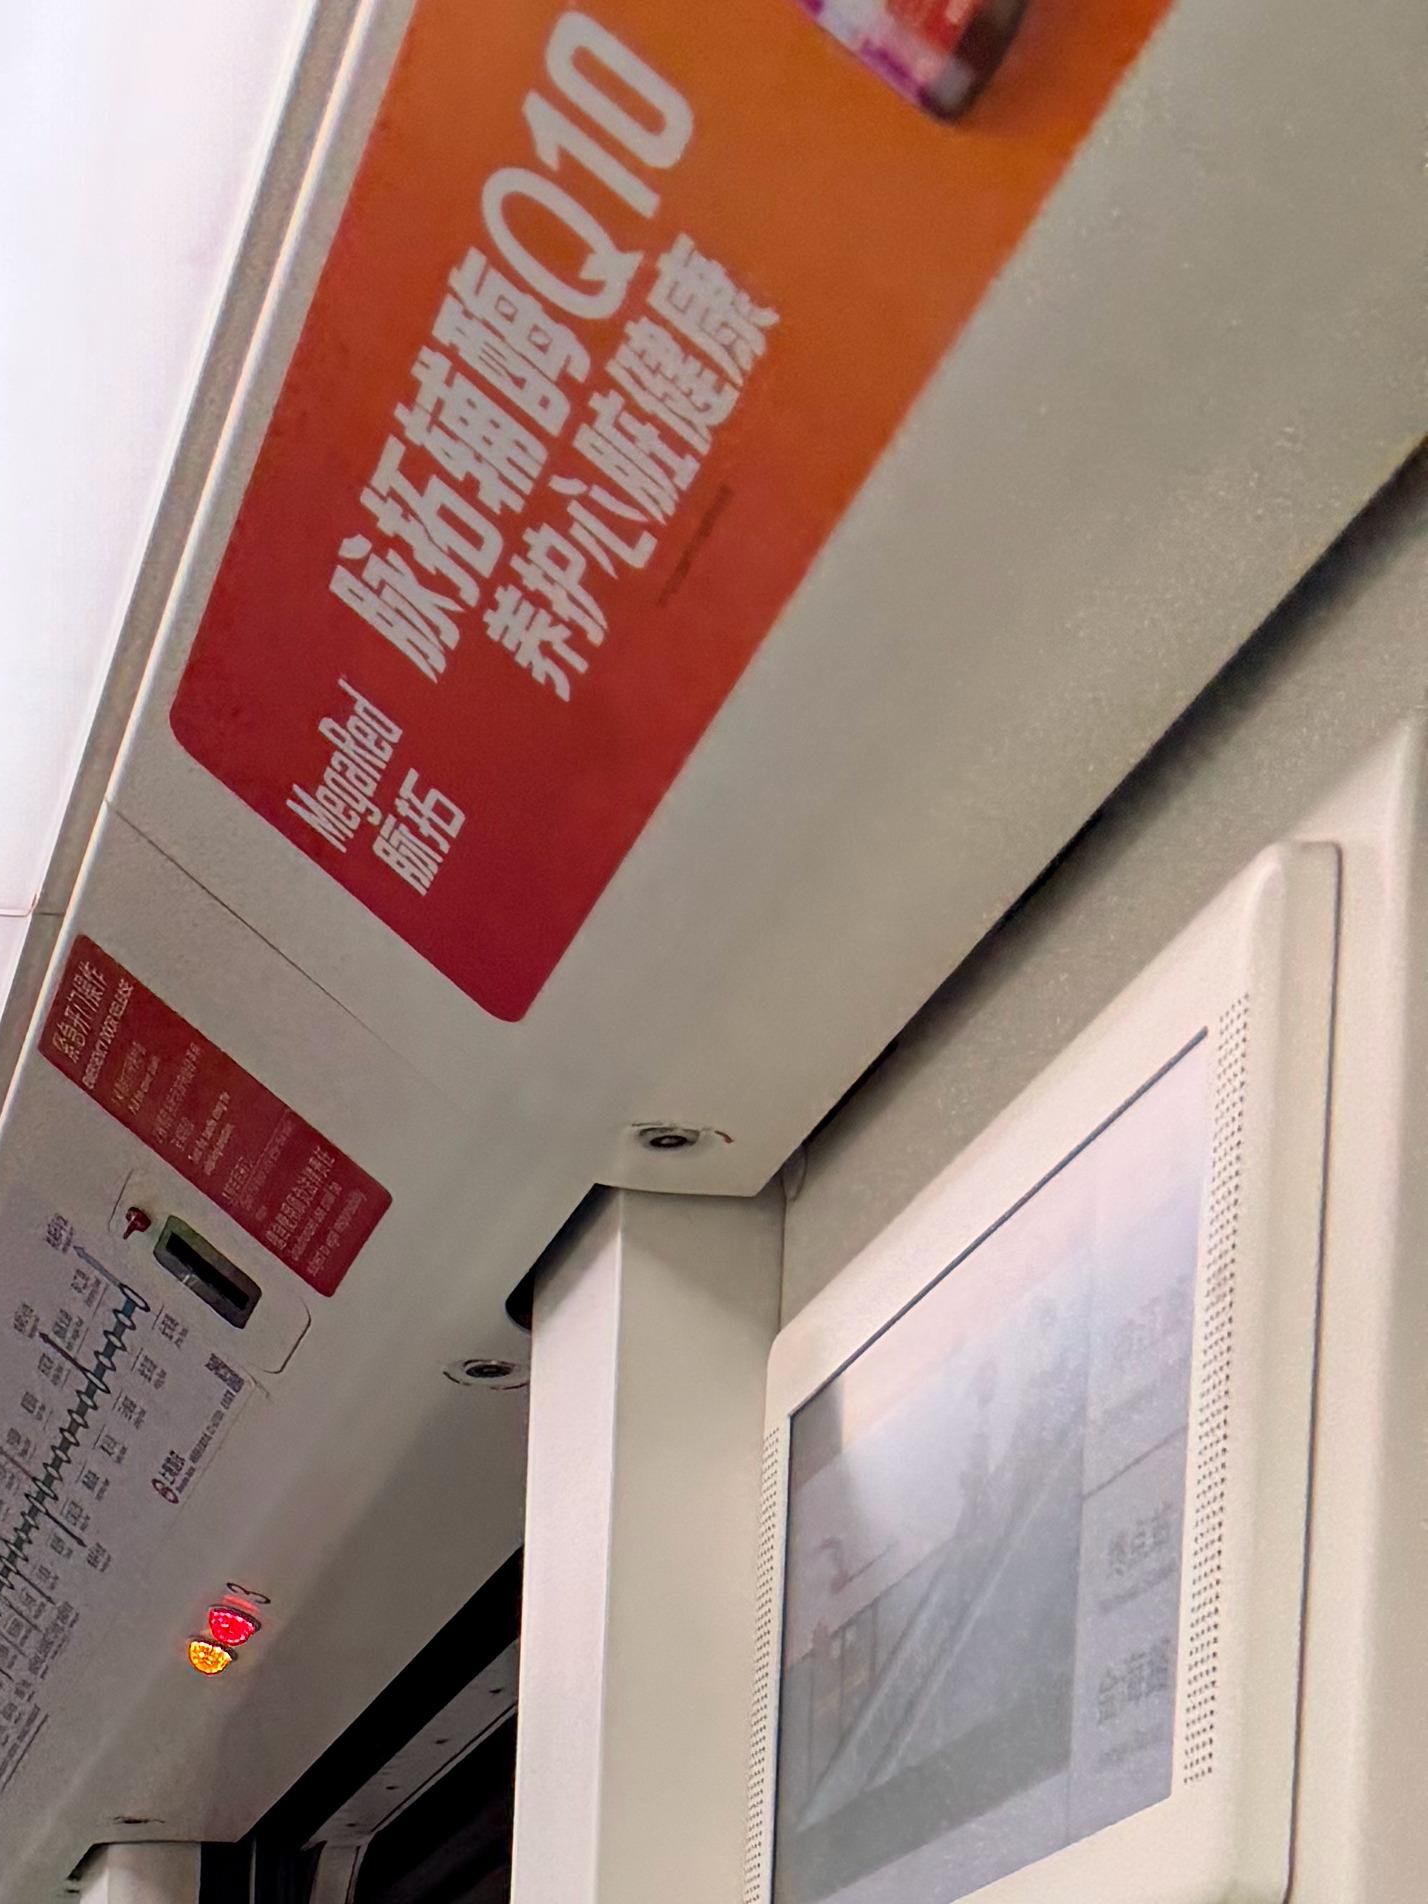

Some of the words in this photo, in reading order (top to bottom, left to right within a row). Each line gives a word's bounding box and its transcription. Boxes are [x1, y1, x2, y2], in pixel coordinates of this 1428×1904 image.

[328, 11, 696, 683] 脉拓辅酶Q10
[482, 236, 780, 702] 养护心脏健康
[286, 678, 403, 852] MegaRed
[371, 768, 466, 895] 脉拓
[52, 960, 107, 1064] 紧急开门操作
